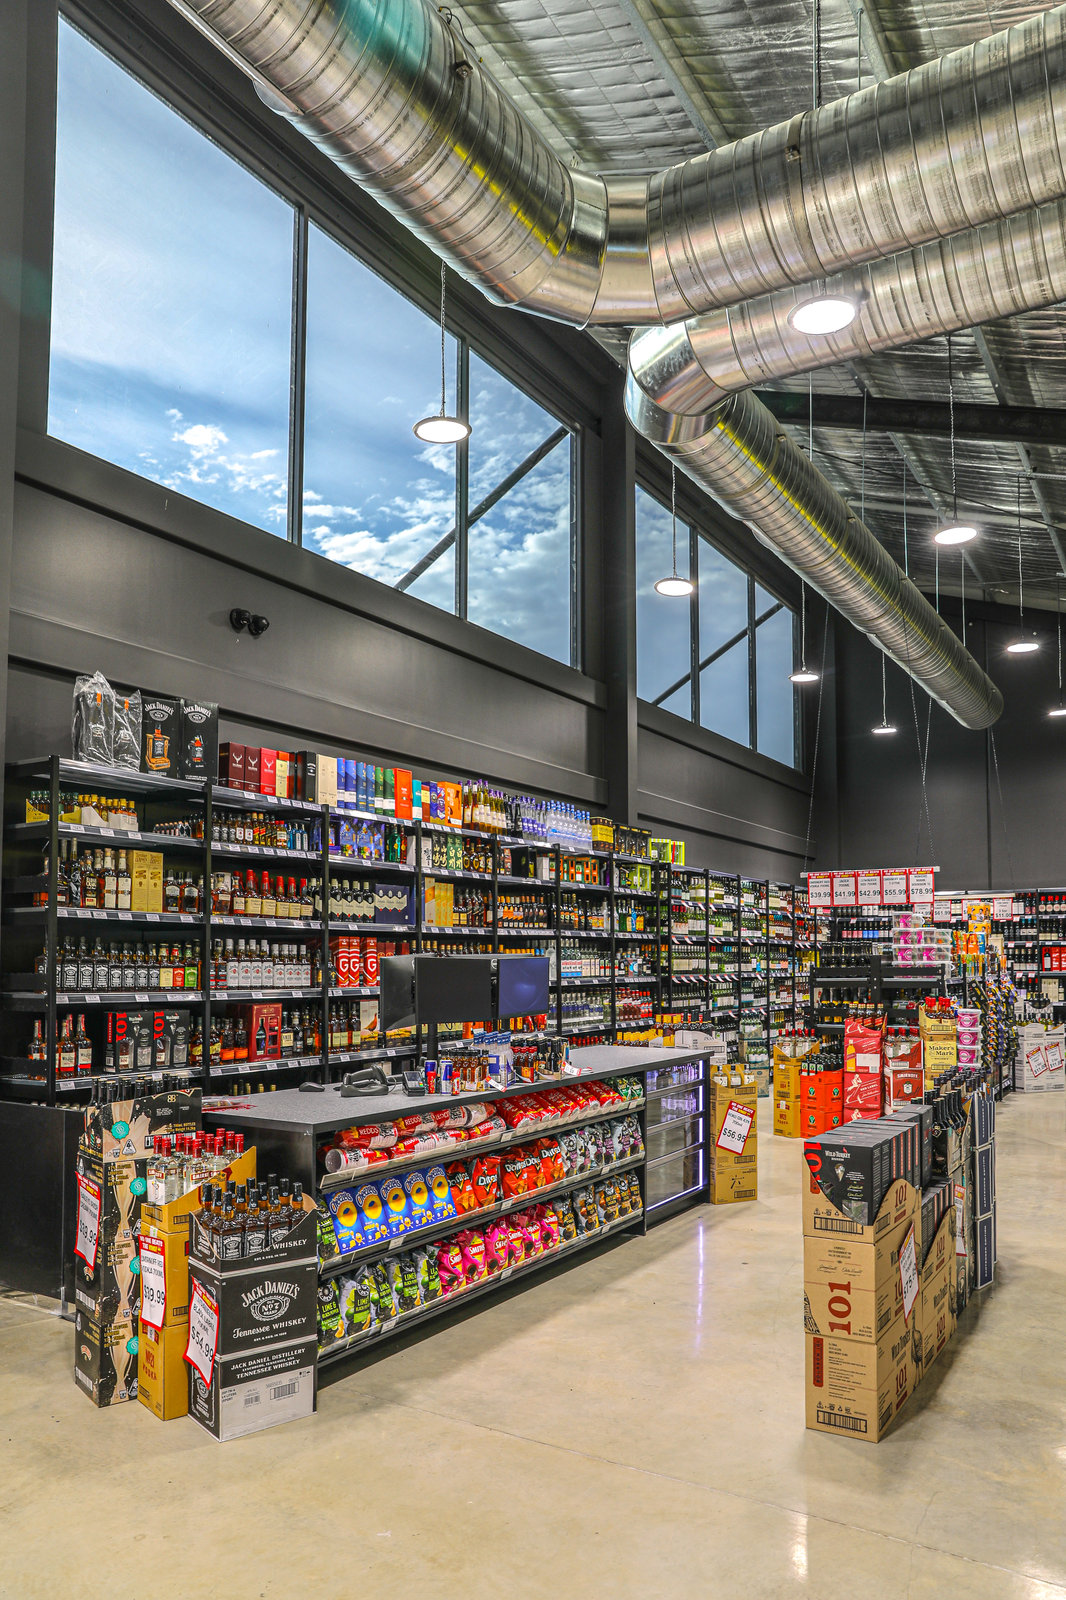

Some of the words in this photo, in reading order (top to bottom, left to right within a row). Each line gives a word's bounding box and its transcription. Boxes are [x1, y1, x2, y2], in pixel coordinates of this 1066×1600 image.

[145, 703, 156, 712] JACK
[183, 706, 195, 714] JACK
[810, 891, 831, 899] $39.99
[834, 890, 856, 898] $41.99
[859, 889, 881, 897] $42.99
[884, 888, 907, 896] $55.99
[910, 887, 933, 895] $78.99
[116, 1012, 128, 1042] 101
[153, 1011, 165, 1041] 101
[722, 1127, 747, 1143] $56.95
[504, 1160, 526, 1172] Doritos
[894, 1182, 908, 1208] 101
[272, 1239, 307, 1250] WHISKEY
[241, 1285, 265, 1308] JACK
[264, 1280, 300, 1299] DANIEL'S
[828, 1281, 852, 1335] 101
[232, 1325, 271, 1339] Tennessee
[272, 1316, 307, 1330] WHISKEY
[191, 1325, 214, 1363] $54.99
[230, 1362, 247, 1371] JACK
[248, 1356, 271, 1366] DANIEL
[271, 1348, 306, 1360] DISTILLERY
[236, 1366, 272, 1379] TENNESSEE
[272, 1359, 301, 1370] WHISKEY
[895, 1363, 908, 1396] 101
